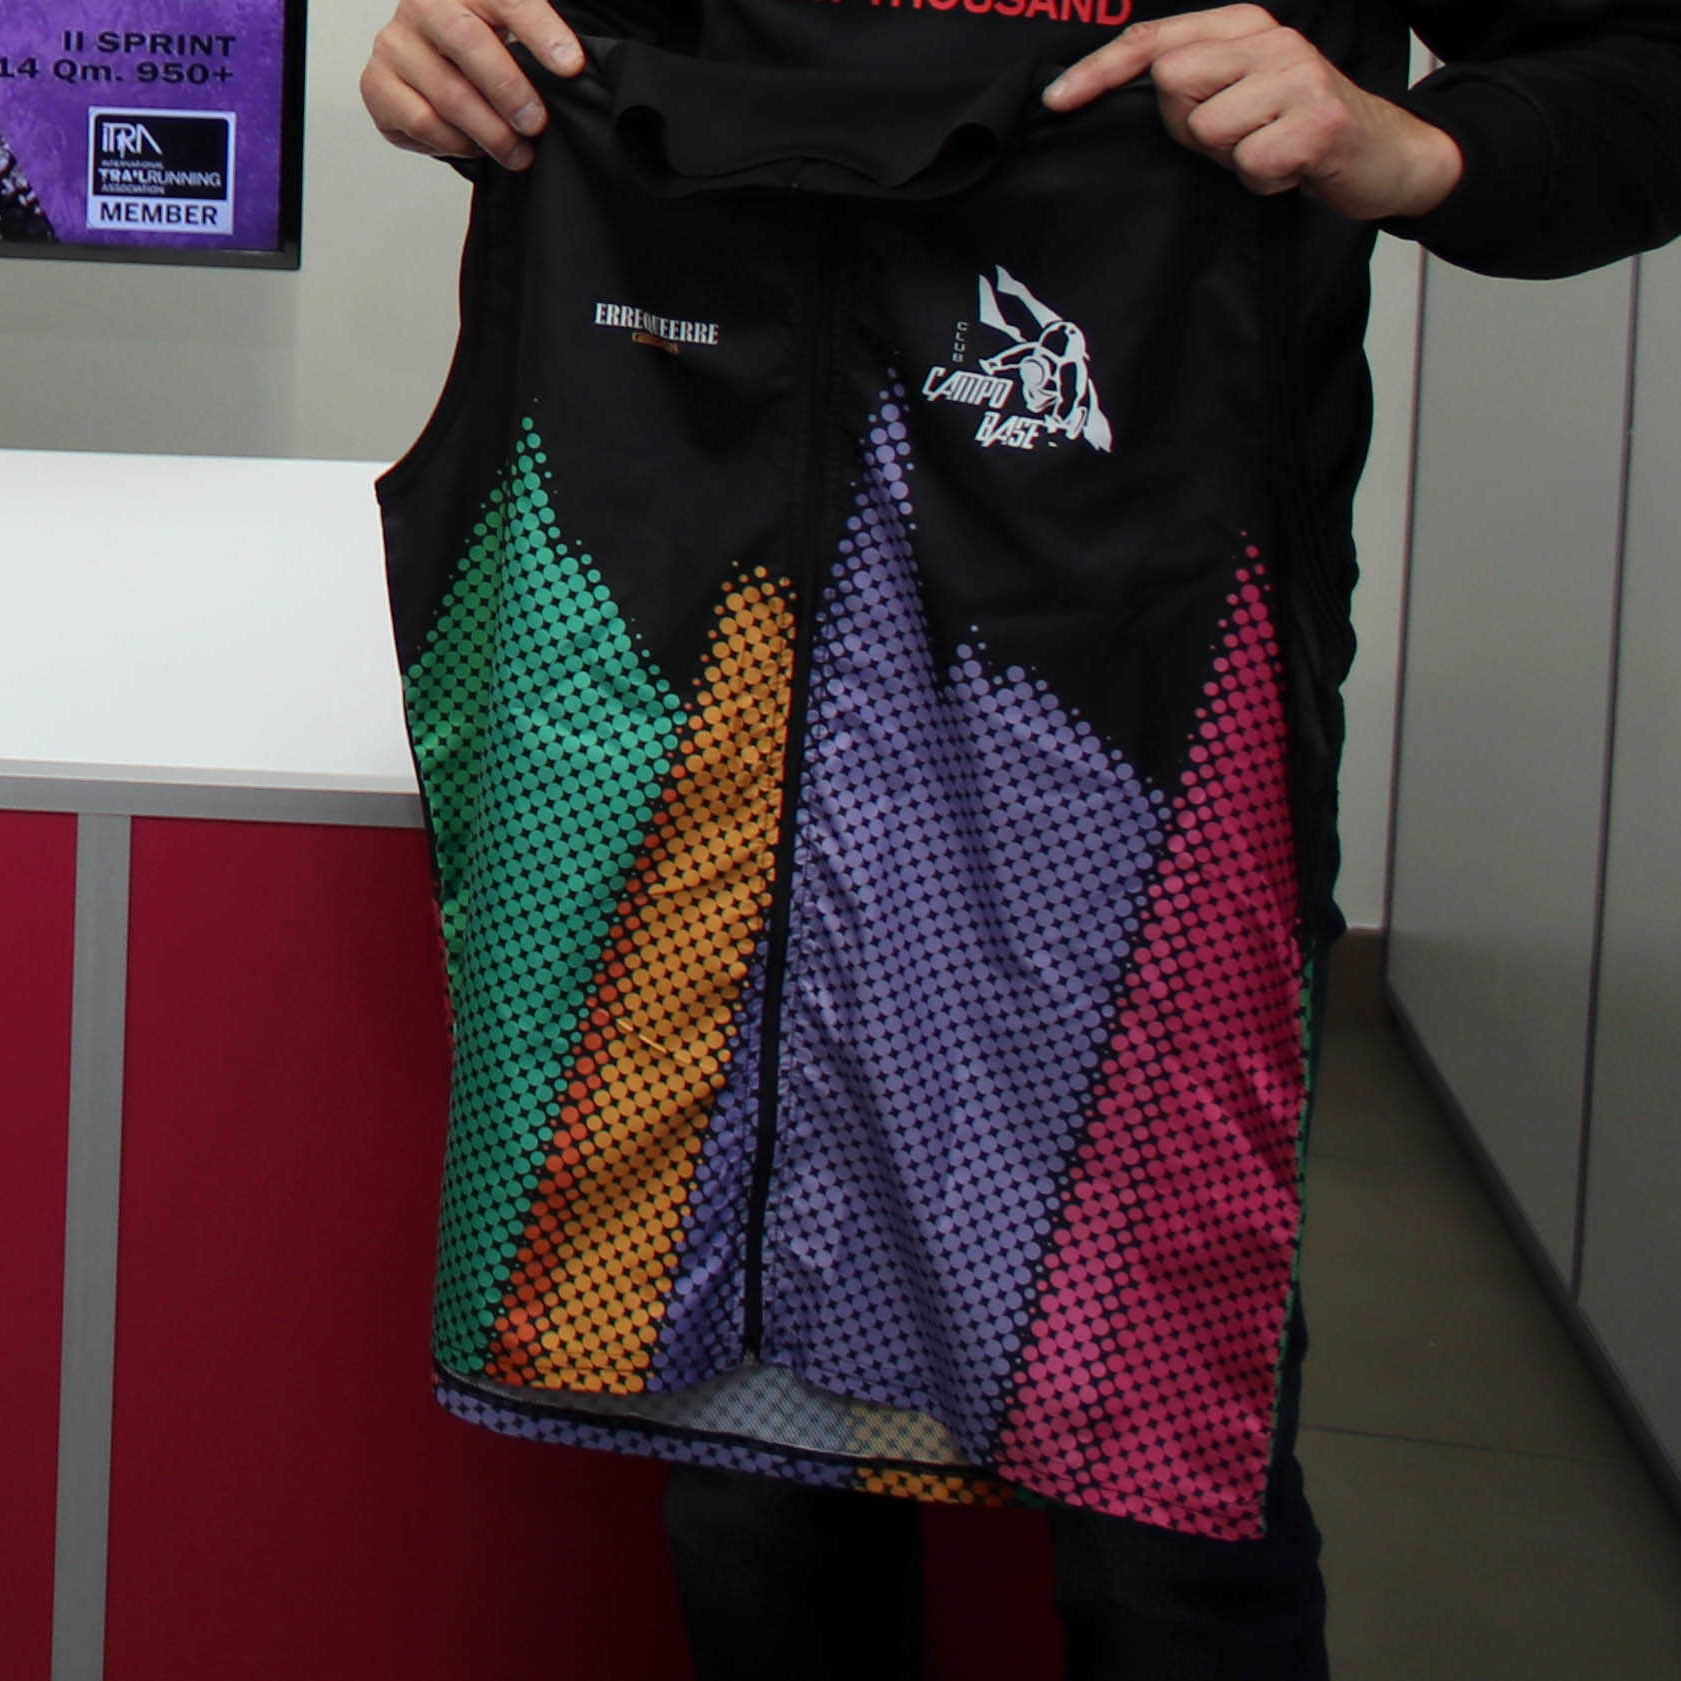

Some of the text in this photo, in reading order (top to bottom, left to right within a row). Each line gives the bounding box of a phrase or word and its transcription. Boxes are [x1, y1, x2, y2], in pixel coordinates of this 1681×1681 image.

[63, 31, 236, 57] II SPRINT
[53, 59, 123, 84] Qm.
[137, 62, 234, 84] 950+
[100, 202, 218, 225] MEMBER
[922, 366, 1014, 409] CAMPO
[975, 411, 1041, 449] BASE
